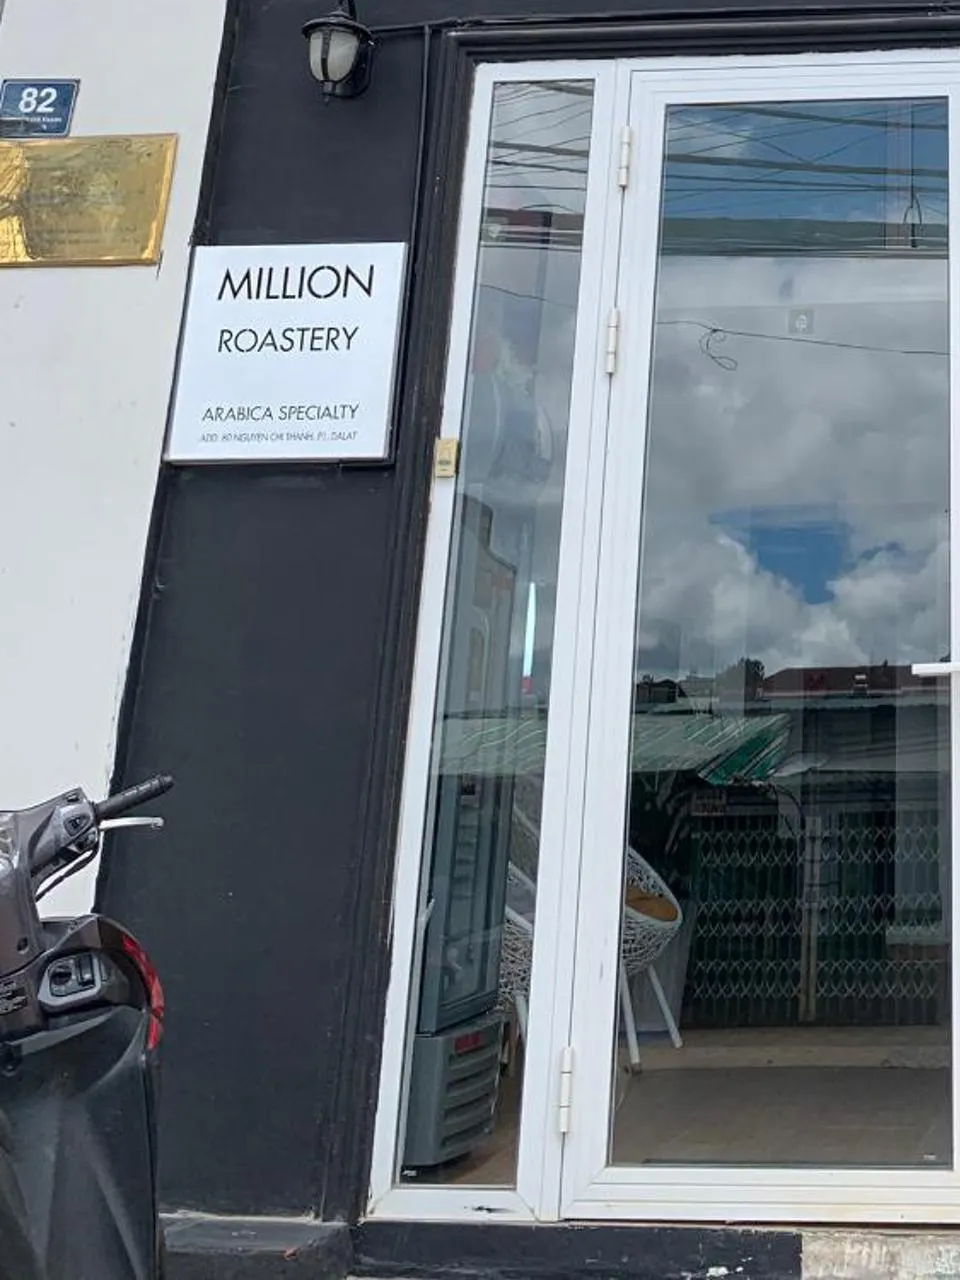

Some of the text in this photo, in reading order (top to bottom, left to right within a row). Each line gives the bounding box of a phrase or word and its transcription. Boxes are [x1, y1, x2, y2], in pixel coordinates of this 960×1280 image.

[18, 87, 57, 113] 82
[217, 264, 375, 301] MILLION
[217, 326, 360, 354] ROASTERY
[202, 404, 360, 421] ARABICA SPECIALTY
